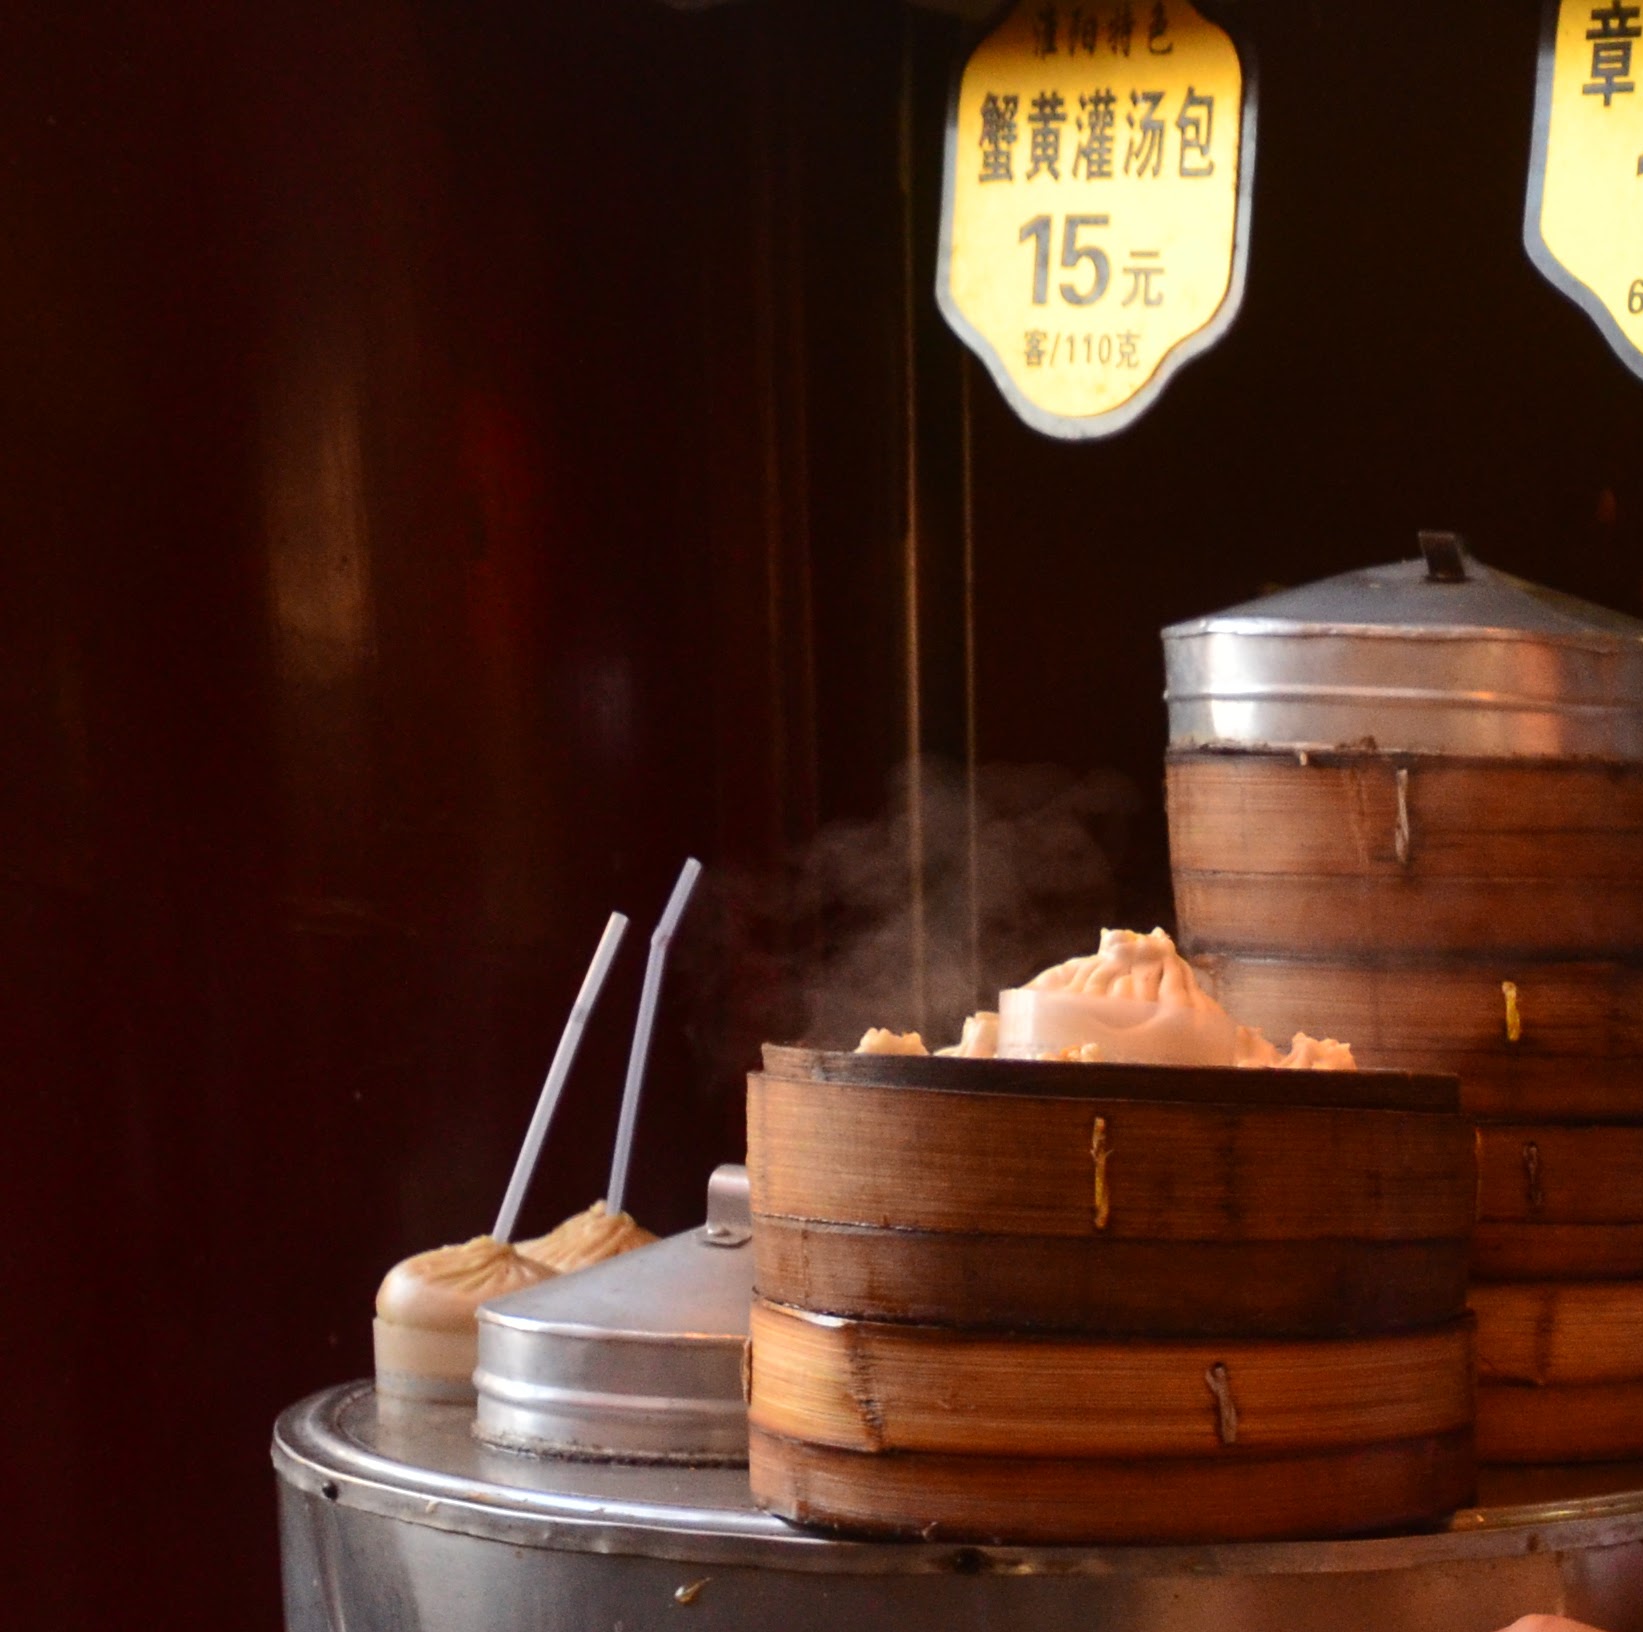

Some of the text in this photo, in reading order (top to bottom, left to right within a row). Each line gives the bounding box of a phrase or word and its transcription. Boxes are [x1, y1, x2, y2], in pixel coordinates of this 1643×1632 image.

[978, 86, 1216, 184] 蟹黄灌汤包
[1023, 330, 1141, 369] 客/110克
